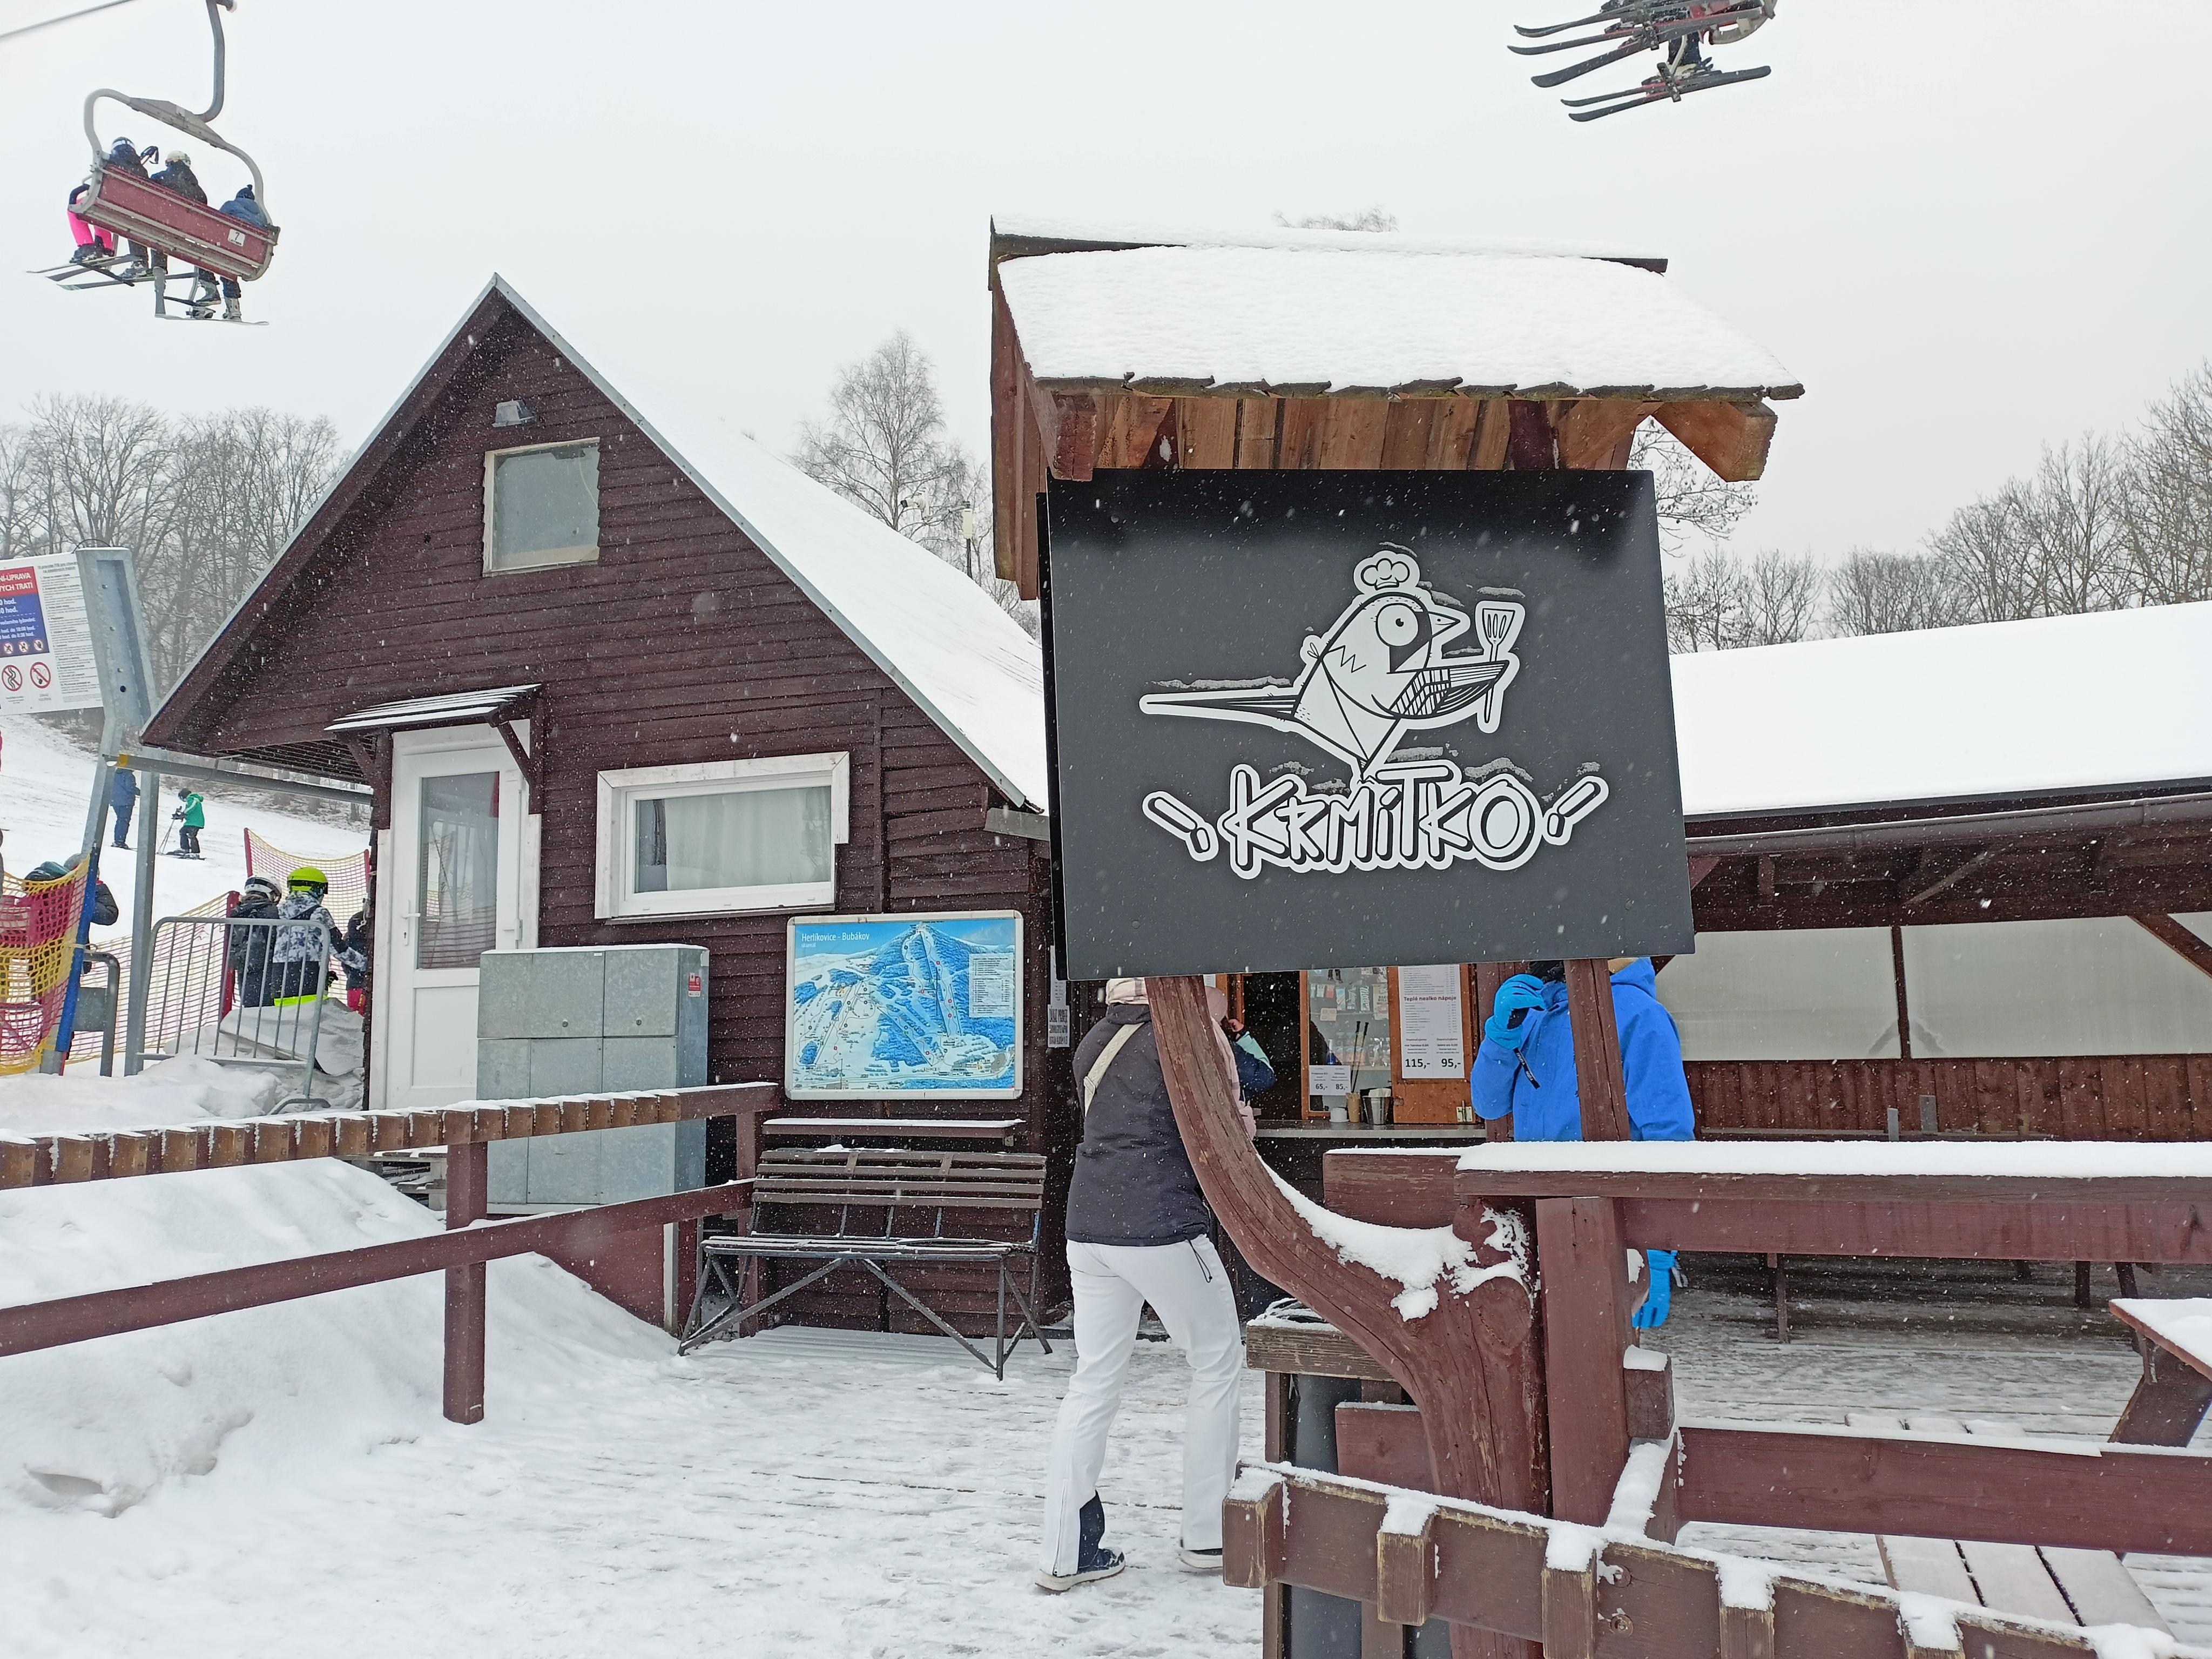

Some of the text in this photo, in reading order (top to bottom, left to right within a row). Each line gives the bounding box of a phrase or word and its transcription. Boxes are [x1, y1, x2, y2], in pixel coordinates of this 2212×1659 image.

[15, 580, 33, 590] TRATÍ
[801, 933, 836, 942] Herlíkovice
[842, 932, 869, 940] Bubákov
[1405, 1058, 1431, 1069] 115,-
[1441, 1058, 1461, 1069] 95,-
